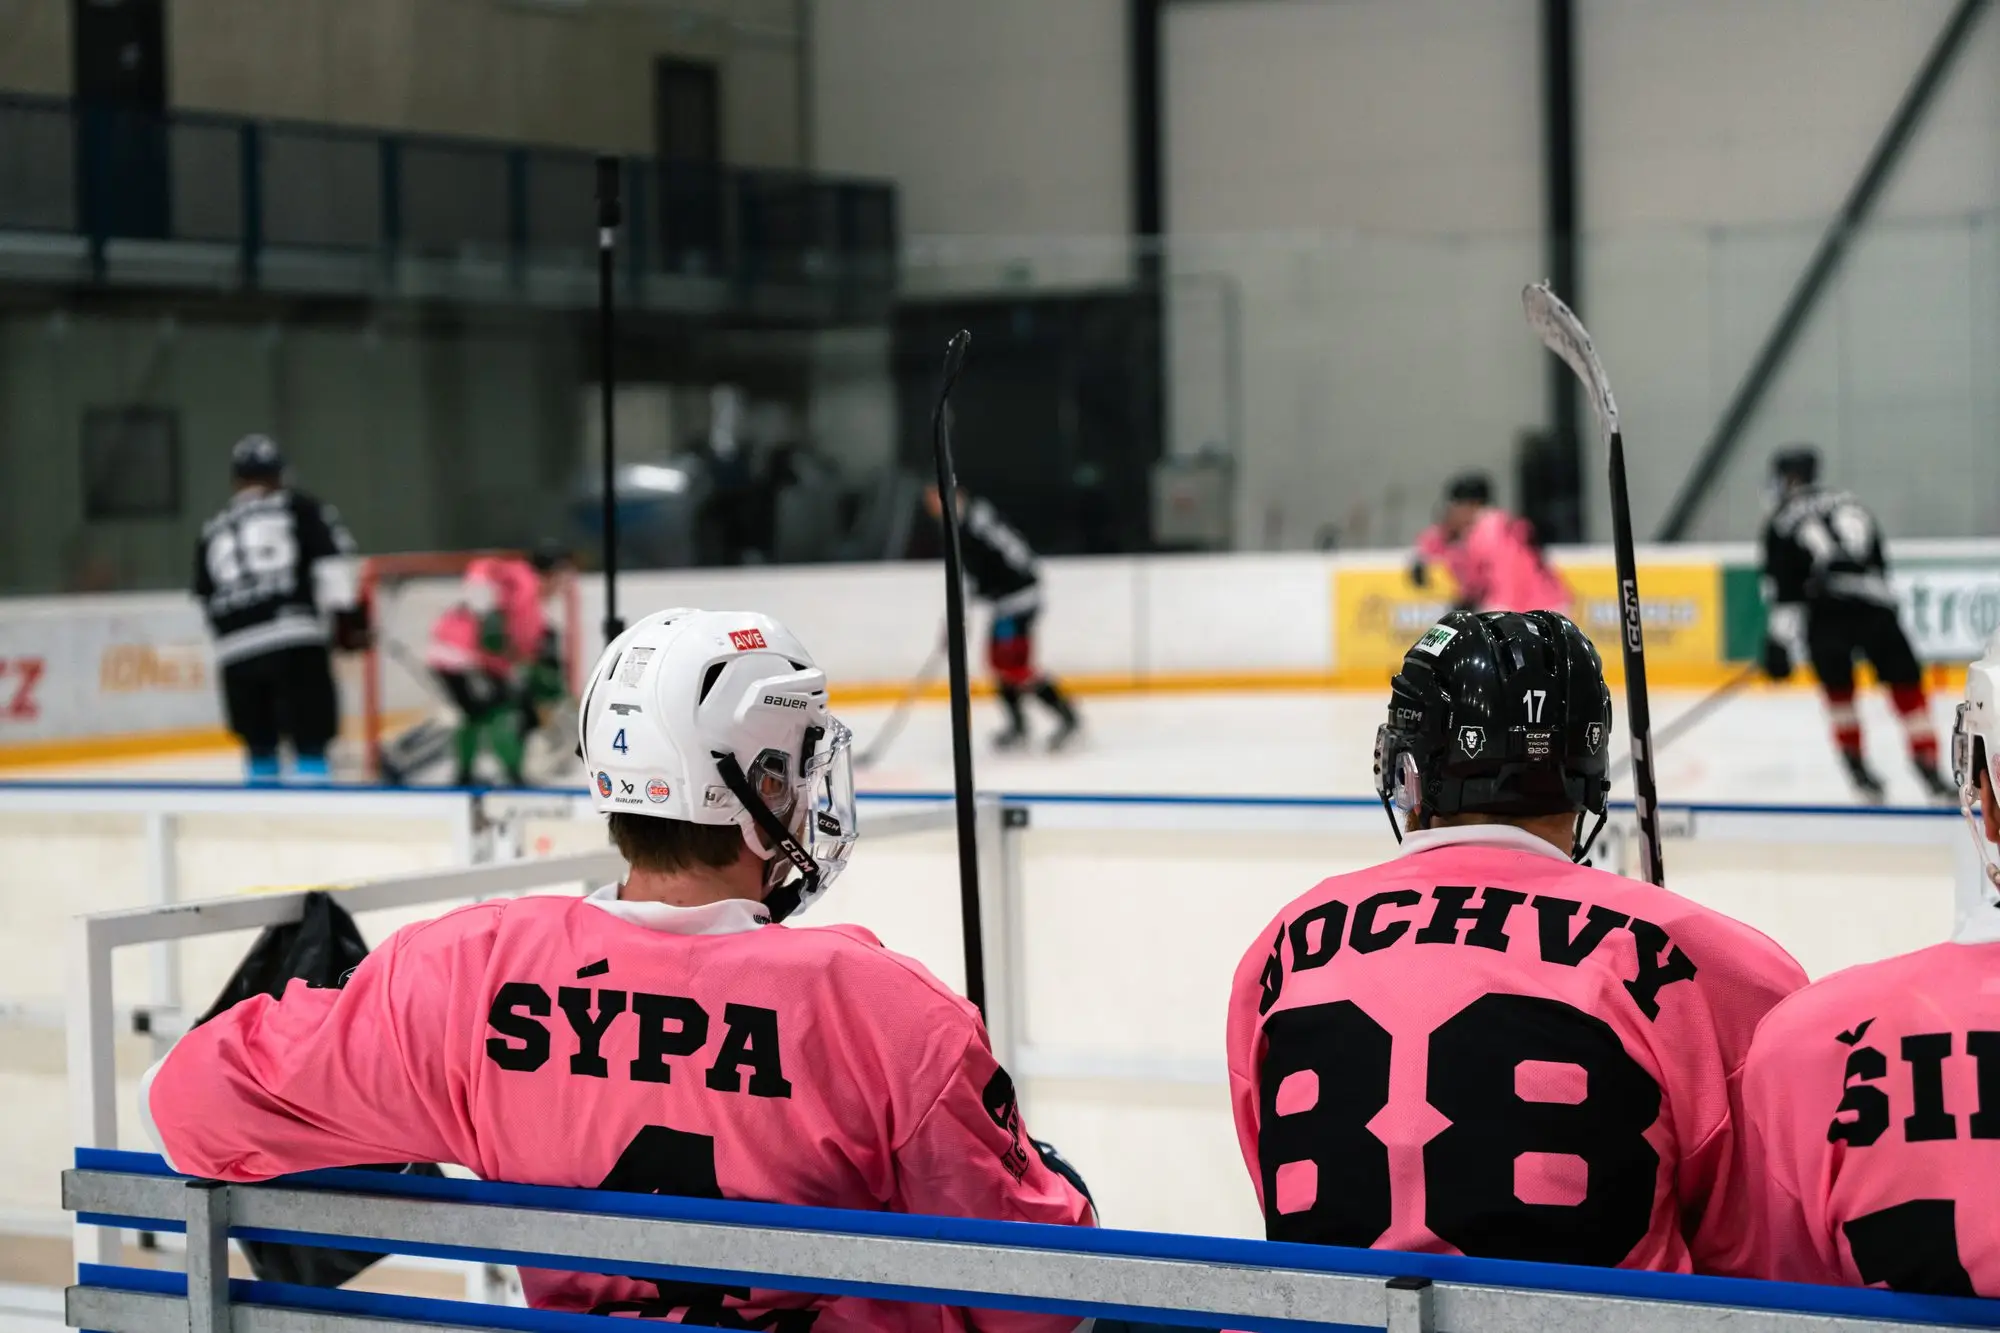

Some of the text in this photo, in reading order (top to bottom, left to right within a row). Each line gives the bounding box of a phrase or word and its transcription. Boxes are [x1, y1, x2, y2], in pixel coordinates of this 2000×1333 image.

[1622, 578, 1641, 650] CCM
[735, 632, 764, 648] AVE
[1396, 707, 1423, 721] CCM
[1522, 689, 1547, 723] 17
[612, 727, 629, 755] 4
[818, 818, 840, 832] CCM
[780, 838, 815, 873] CCM
[485, 957, 793, 1100] SÝPA
[1257, 991, 1663, 1270] 88
